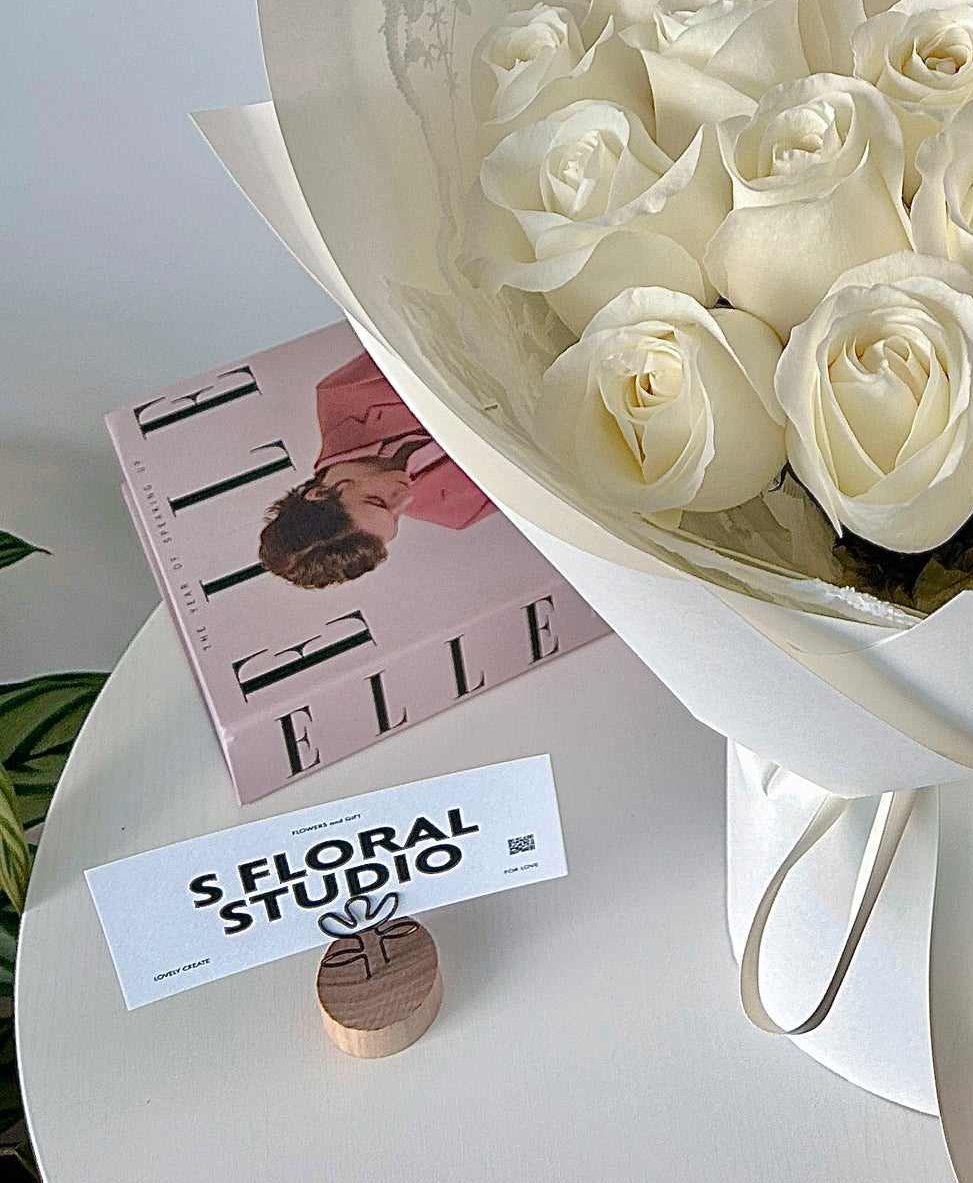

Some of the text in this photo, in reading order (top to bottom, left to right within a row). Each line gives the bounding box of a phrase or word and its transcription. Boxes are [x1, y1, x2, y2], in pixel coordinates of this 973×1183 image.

[133, 460, 146, 473] UP
[170, 557, 183, 571] OF
[180, 582, 198, 614] YEAR
[196, 626, 212, 652] THE
[275, 595, 561, 778] ELLE
[291, 822, 328, 836] FLOWERS
[188, 808, 479, 909] S FLORAL
[218, 843, 463, 936] STUDIO
[153, 958, 211, 982] LOVELY CREATE
